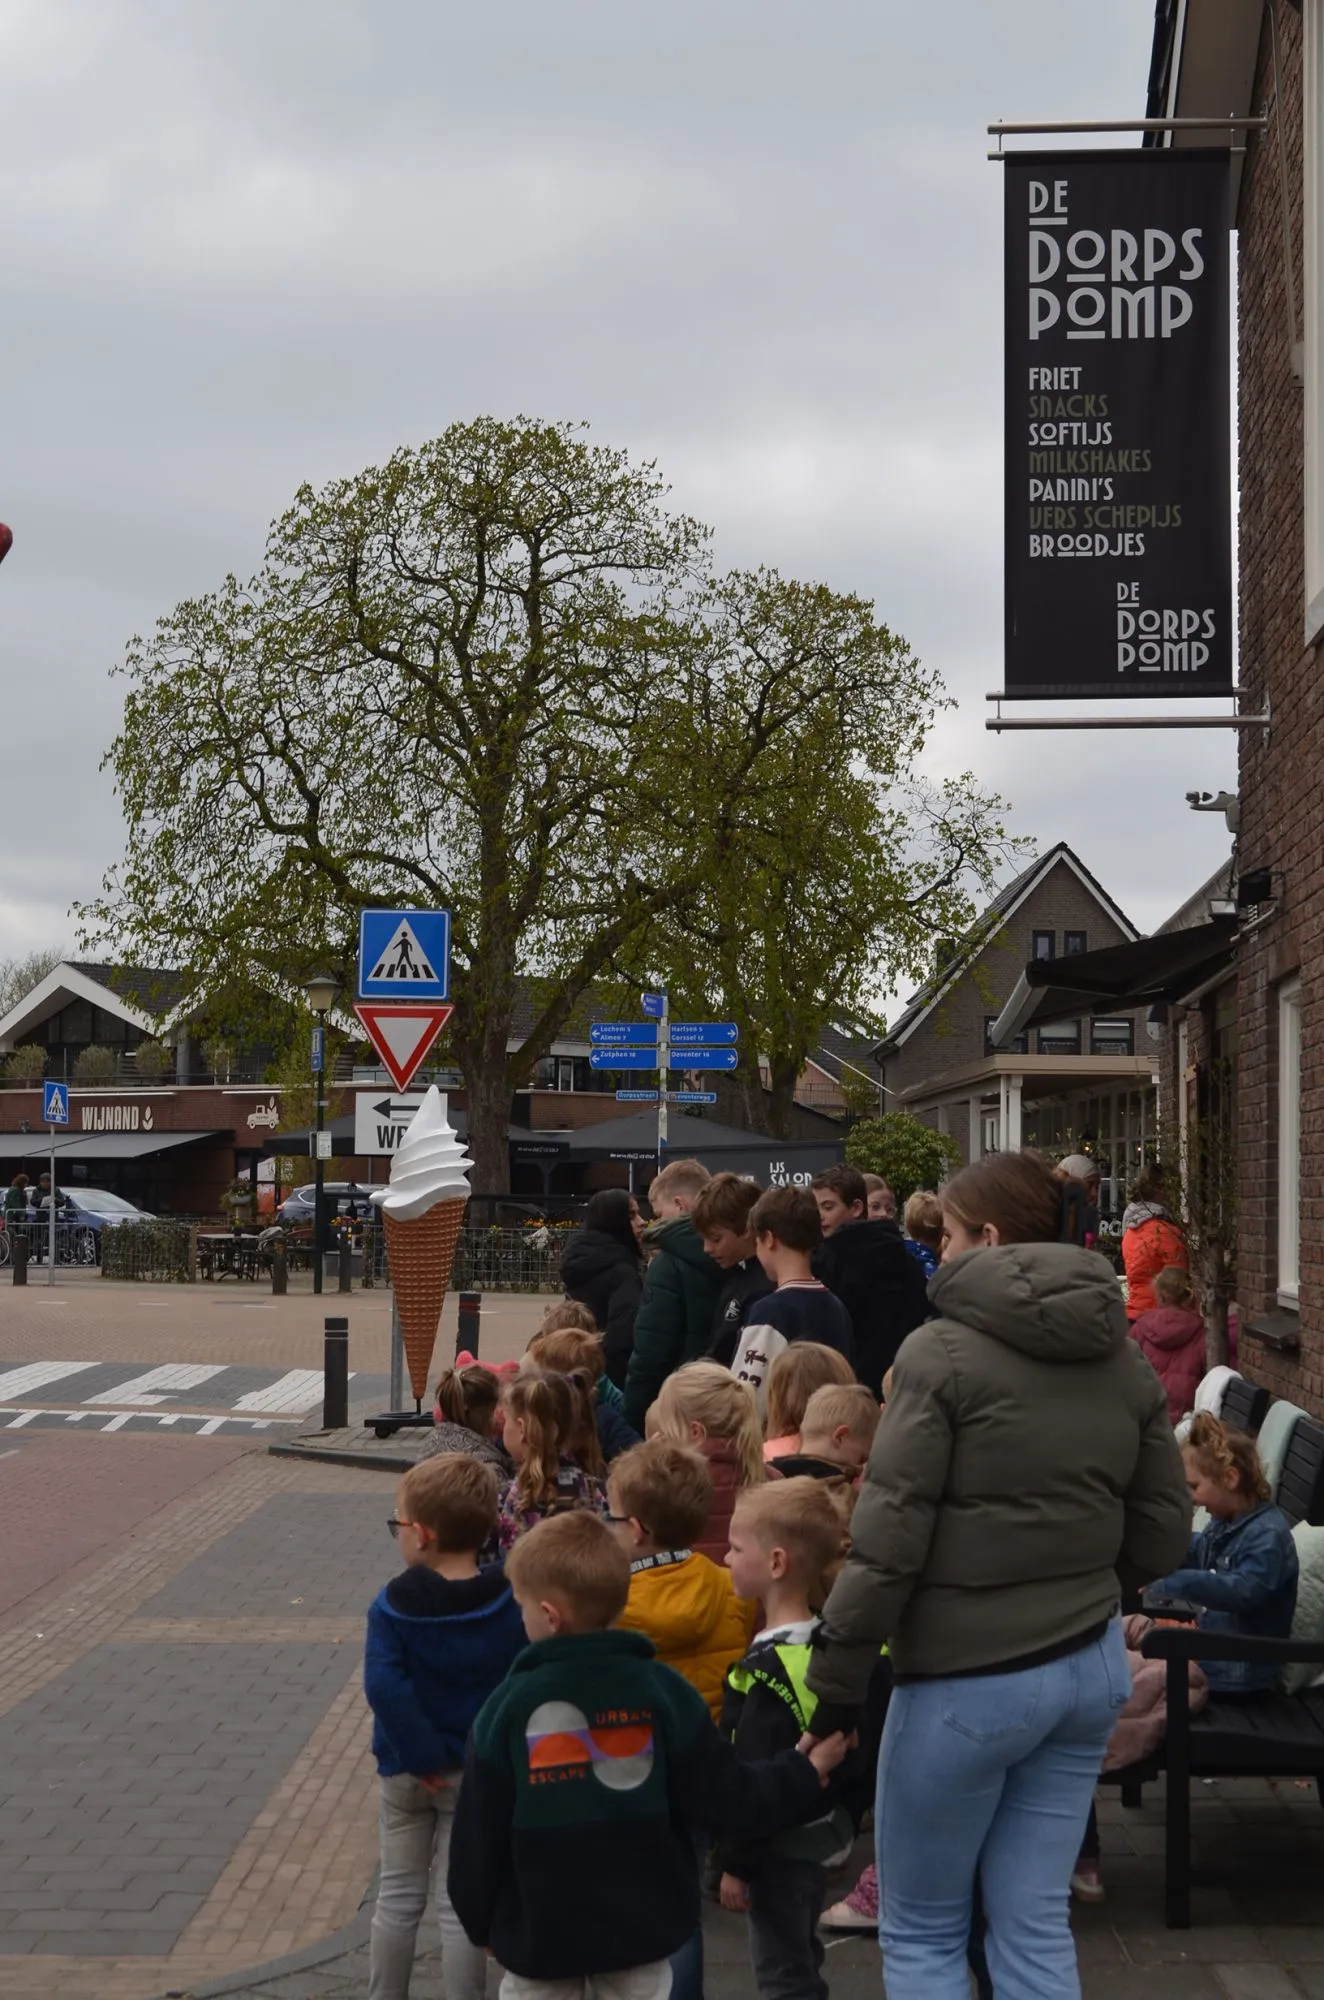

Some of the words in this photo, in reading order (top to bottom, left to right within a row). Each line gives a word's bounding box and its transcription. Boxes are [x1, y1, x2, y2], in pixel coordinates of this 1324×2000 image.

[1029, 180, 1068, 215] DE
[1029, 228, 1204, 283] DORPS
[1029, 286, 1193, 340] POMP
[1028, 366, 1083, 391] FRIET
[1028, 393, 1109, 419] SNACKS
[1028, 421, 1113, 446] SOFTIJS
[1028, 448, 1153, 474] MILKSHAKES
[1028, 478, 1114, 502] PANINI'S
[1028, 505, 1077, 530] VERS
[1083, 504, 1183, 530] SCHEPIJS
[1028, 532, 1146, 558] BROODJES
[1117, 581, 1140, 601] DE
[1117, 608, 1216, 640] DORPS
[1117, 641, 1210, 672] POMP
[671, 1034, 697, 1042] Gorssel
[600, 1051, 628, 1059] Zutphen
[82, 1106, 139, 1131] WIJNAND
[769, 1162, 785, 1174] IJS
[595, 1707, 653, 1725] URBAN
[529, 1767, 587, 1785] ESCAPE
